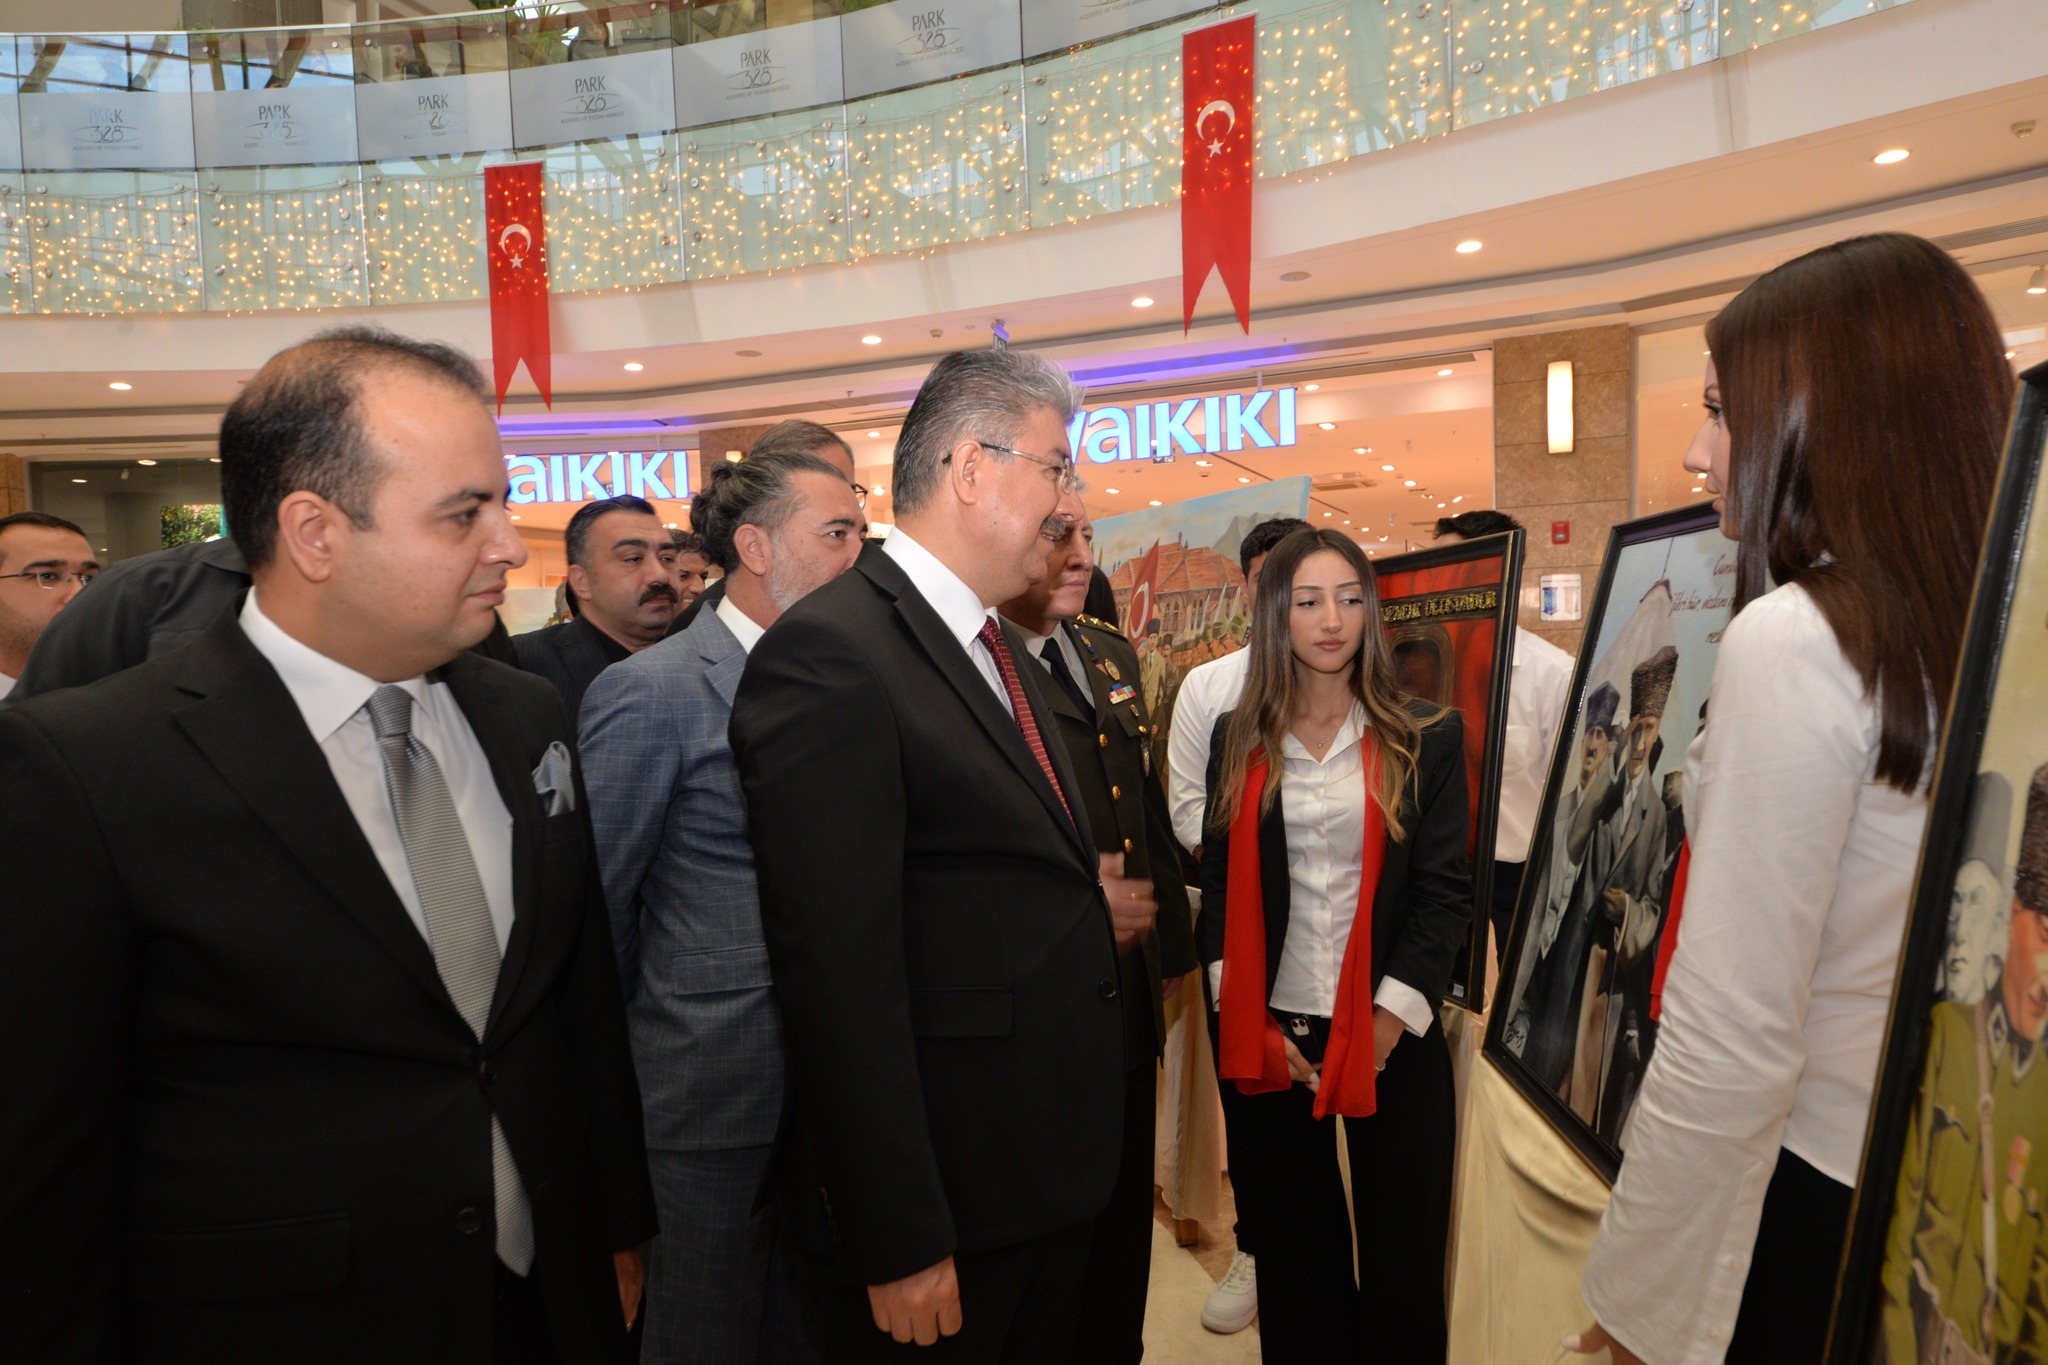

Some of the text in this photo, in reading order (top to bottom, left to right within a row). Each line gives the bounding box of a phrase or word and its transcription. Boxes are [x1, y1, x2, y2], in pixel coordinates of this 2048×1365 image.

[912, 8, 945, 31] PARK
[913, 28, 946, 53] 328
[740, 48, 771, 68] PARK
[575, 75, 606, 94] PARK
[741, 66, 772, 89] 328
[418, 94, 449, 111] PARK
[576, 94, 606, 113] 328
[89, 109, 123, 123] PARK
[258, 105, 291, 120] PARK
[90, 125, 124, 143] 328
